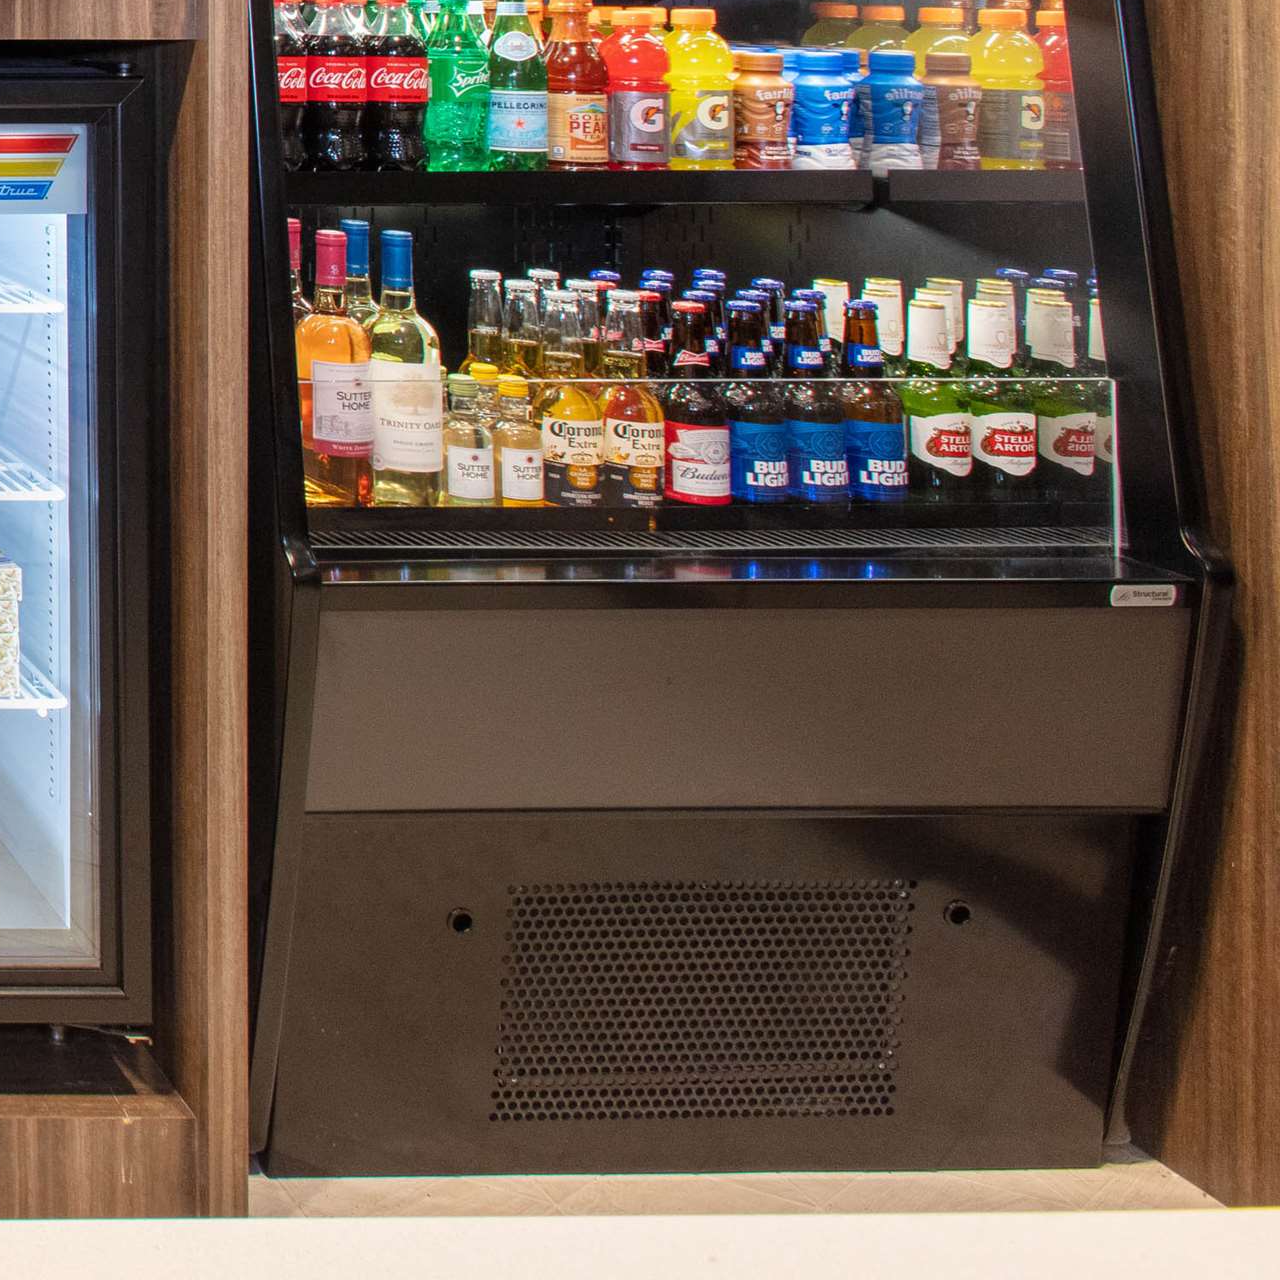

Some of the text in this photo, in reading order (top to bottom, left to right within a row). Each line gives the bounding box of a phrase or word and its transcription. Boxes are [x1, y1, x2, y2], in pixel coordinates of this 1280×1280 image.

[342, 401, 370, 411] HOME
[379, 418, 421, 430] TRINITY
[753, 460, 788, 474] BUD
[809, 459, 848, 473] BUD
[867, 459, 907, 473] BUD
[859, 470, 910, 486] LIGHT
